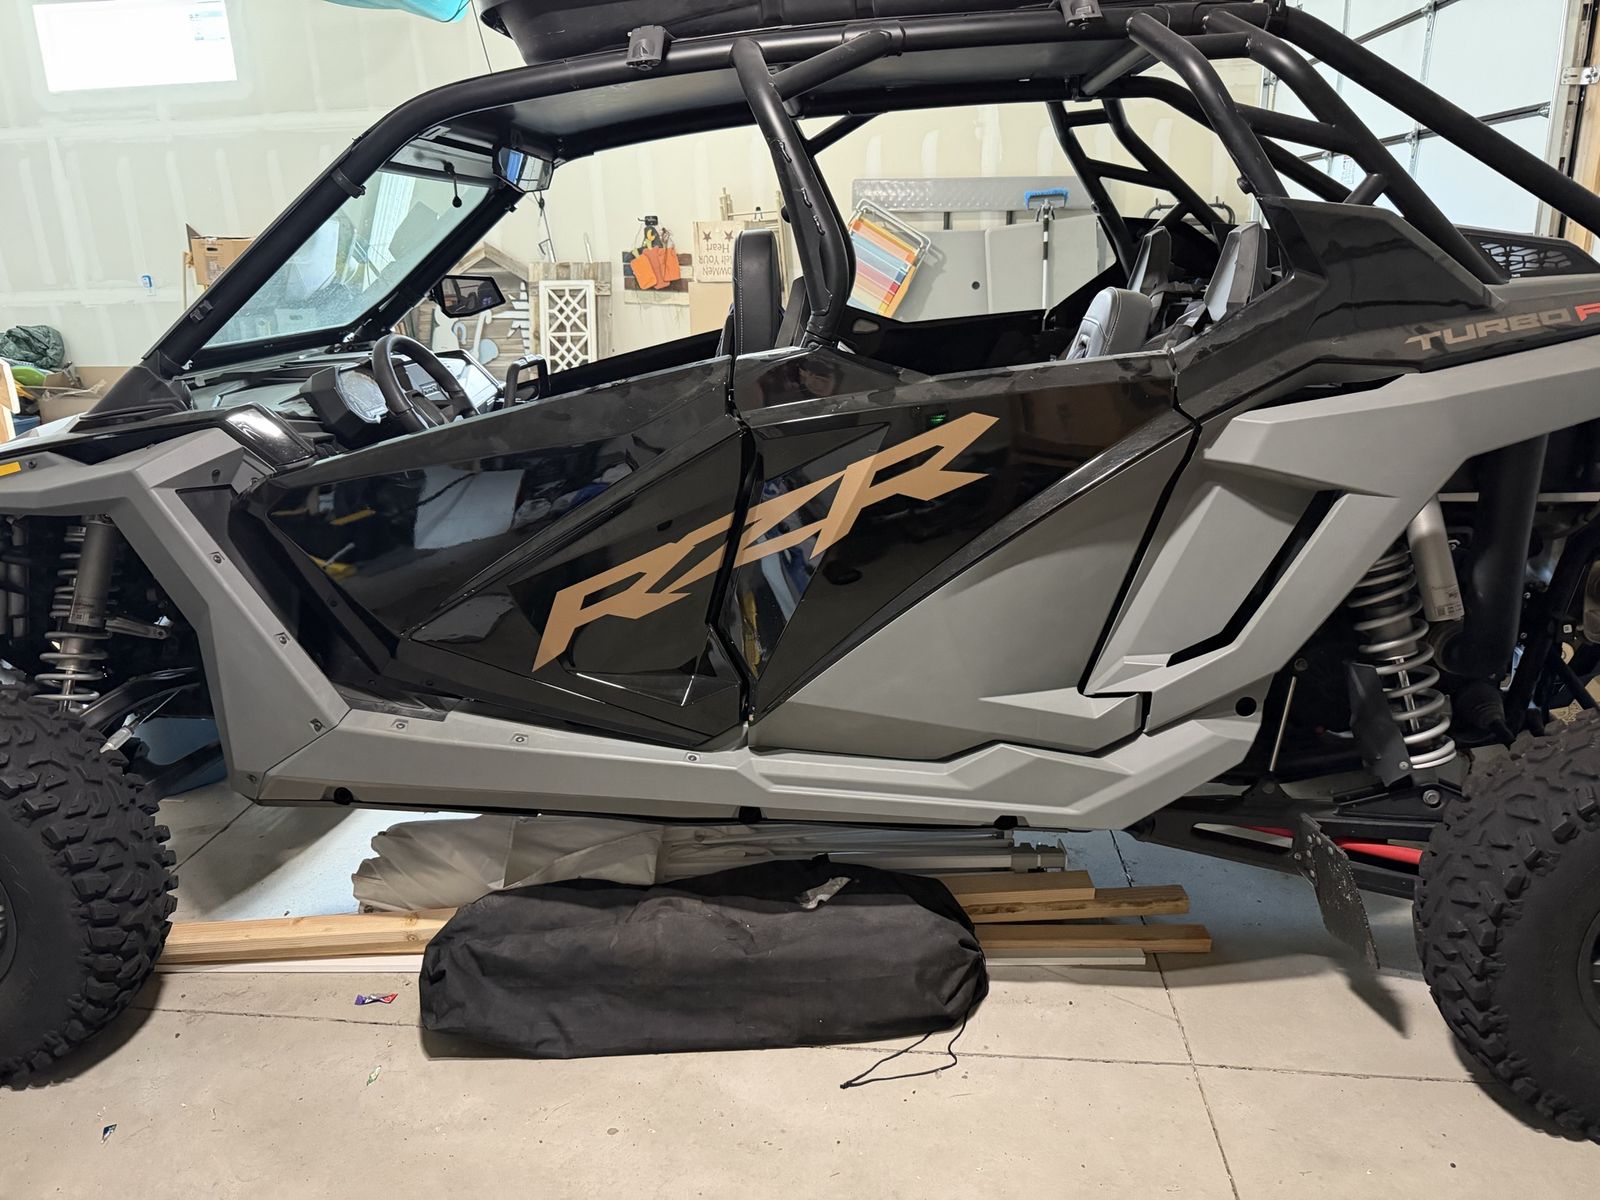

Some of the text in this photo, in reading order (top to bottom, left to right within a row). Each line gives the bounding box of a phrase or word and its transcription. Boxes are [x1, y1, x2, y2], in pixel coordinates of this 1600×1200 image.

[706, 242, 730, 253] Heart
[721, 256, 732, 265] elt
[1404, 308, 1572, 351] TURBO
[532, 411, 999, 672] RZR
